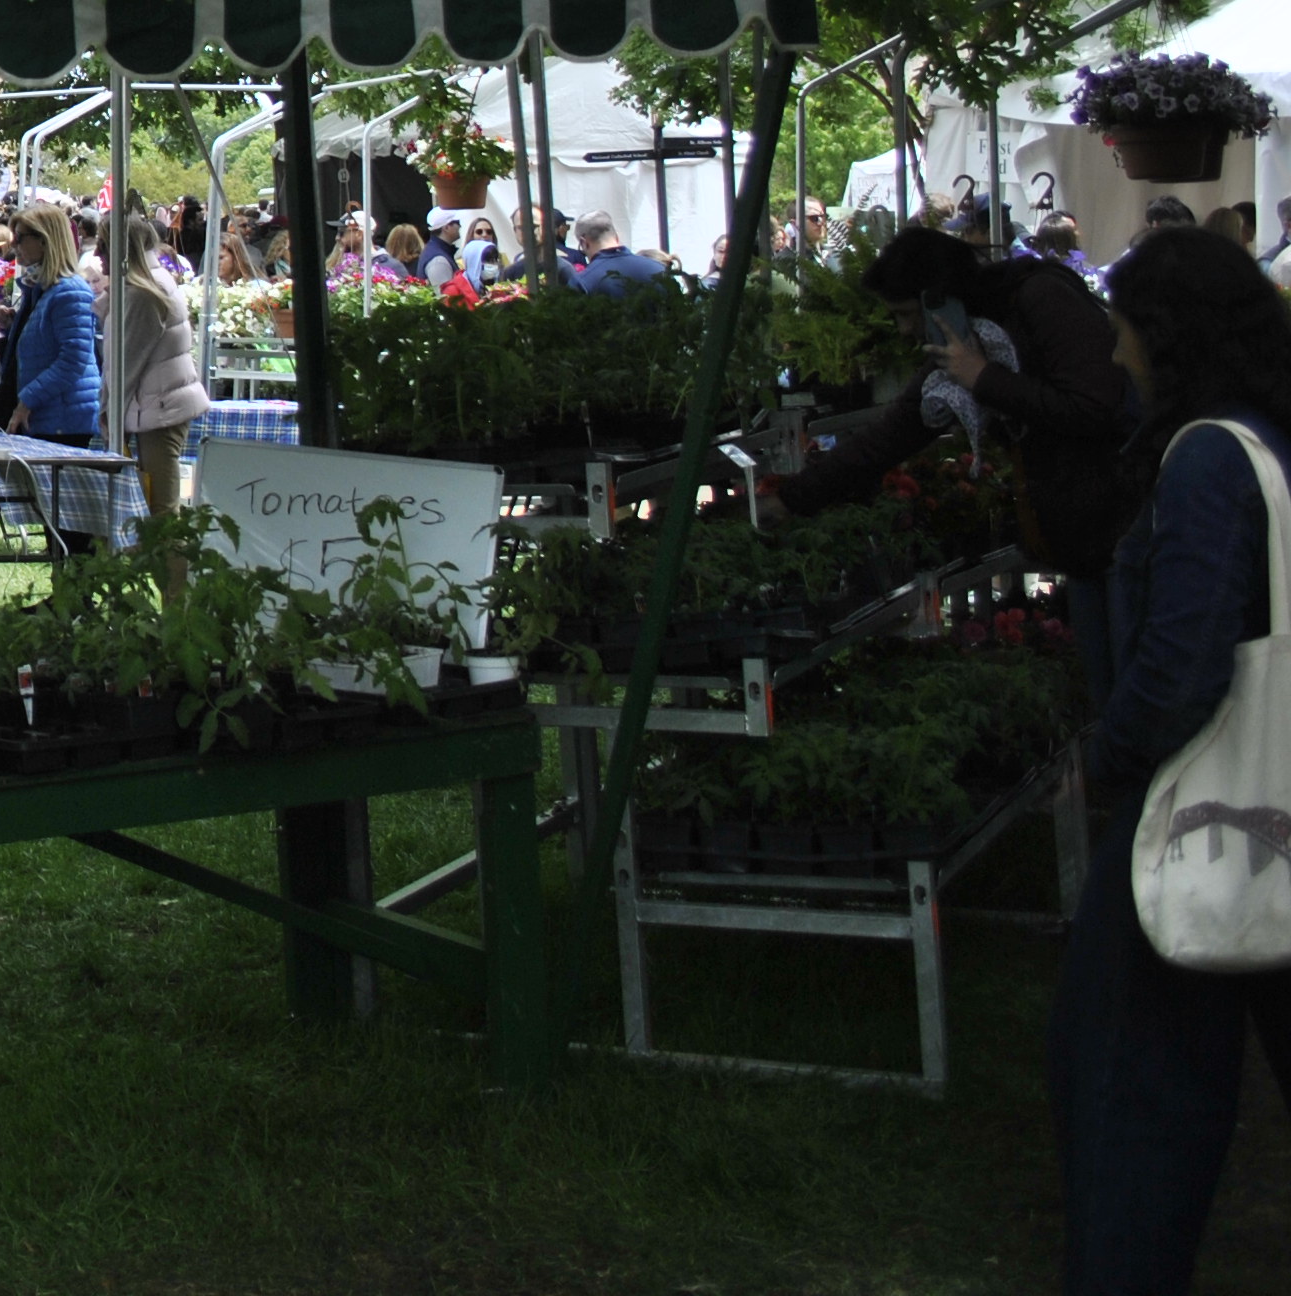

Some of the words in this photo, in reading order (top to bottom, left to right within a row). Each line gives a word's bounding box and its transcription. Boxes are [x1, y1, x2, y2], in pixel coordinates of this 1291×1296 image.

[979, 138, 1011, 154] Fst
[982, 159, 1007, 174] Ad
[236, 477, 446, 526] Tomates
